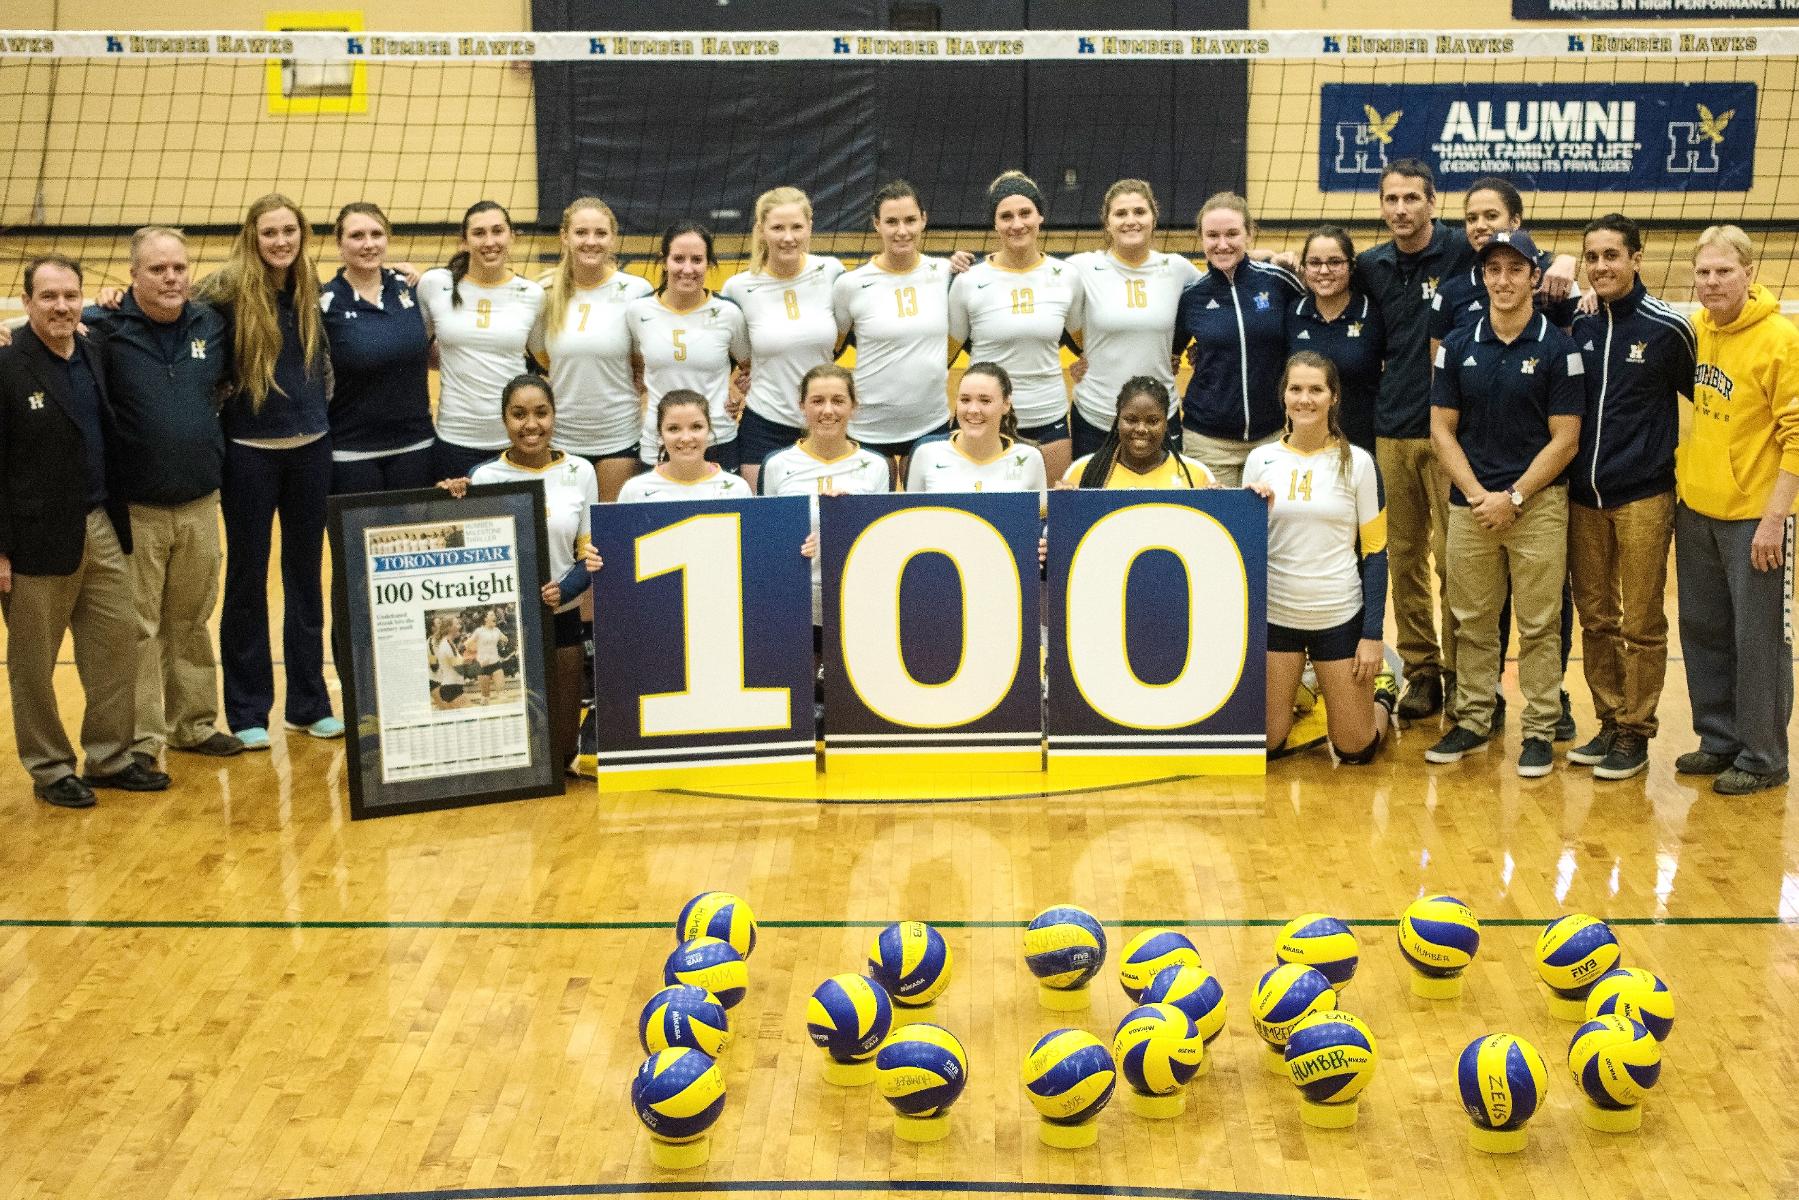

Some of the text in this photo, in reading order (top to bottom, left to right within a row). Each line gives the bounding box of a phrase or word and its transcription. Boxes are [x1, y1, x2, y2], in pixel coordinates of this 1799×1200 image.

[1440, 101, 1637, 142] ALUMNI
[1494, 143, 1556, 159] FAMILY
[1558, 143, 1593, 159] FOR
[783, 289, 800, 321] 8
[894, 287, 919, 318] 13
[1125, 278, 1148, 308] 16
[476, 299, 491, 329] 9
[577, 303, 591, 332] 7
[672, 329, 687, 361] 5
[1287, 469, 1312, 501] 14
[381, 546, 505, 571] TORONTO STAR
[375, 573, 514, 605] 100 Straight
[688, 906, 705, 941] HUMBE
[1073, 952, 1089, 961] FIVB
[1282, 944, 1305, 955] MIKASA
[1413, 943, 1451, 962] HUMBER
[1571, 958, 1598, 978] FIVB
[672, 1010, 682, 1040] MIKASA
[1623, 1003, 1632, 1019] MIK
[1291, 1049, 1349, 1082] HUMBER
[1606, 1057, 1618, 1081] MVA200
[1488, 1074, 1507, 1120] ZEUS
